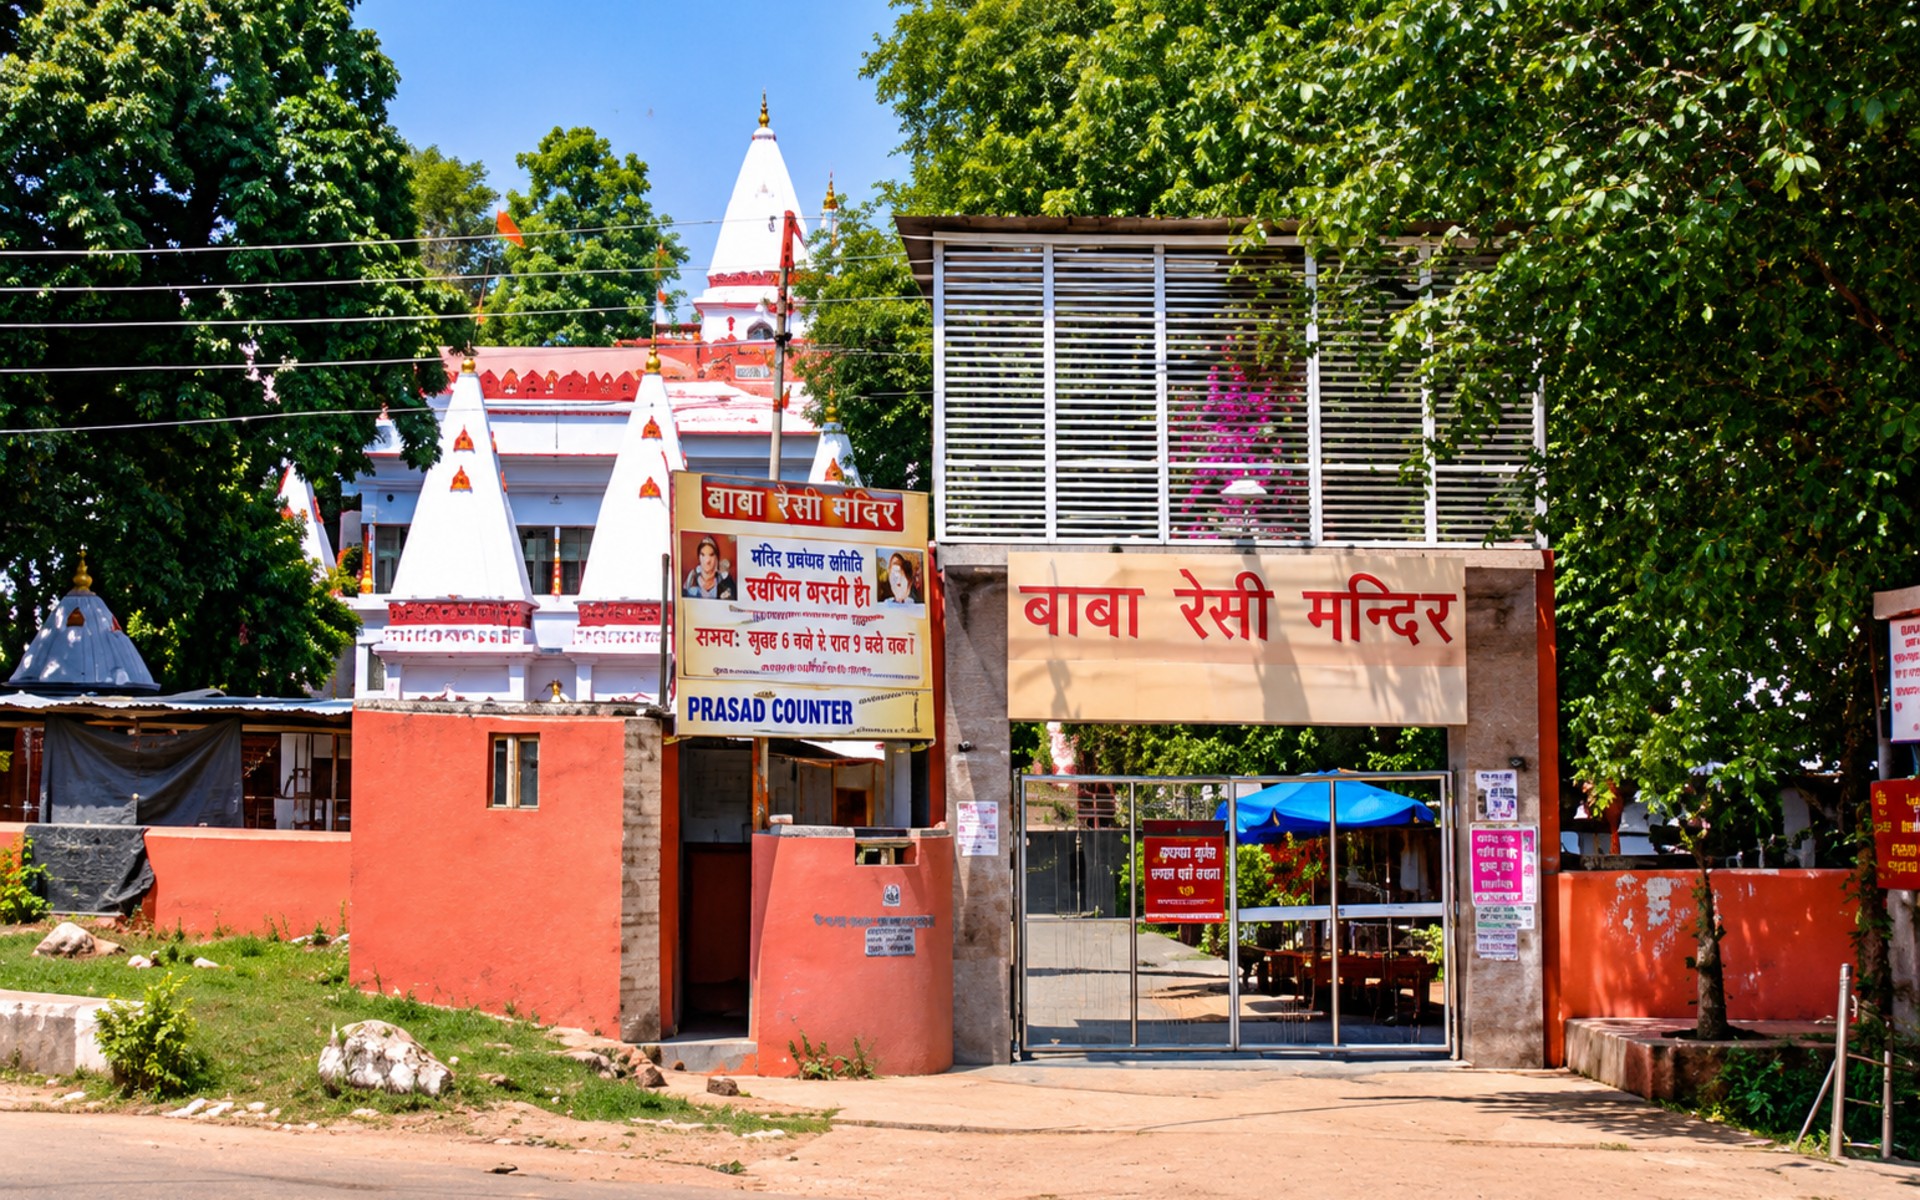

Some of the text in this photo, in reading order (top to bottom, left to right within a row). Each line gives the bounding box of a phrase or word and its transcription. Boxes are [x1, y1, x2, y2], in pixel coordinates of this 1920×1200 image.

[706, 486, 765, 517] बाबा
[832, 489, 897, 527] मंदिर
[1019, 568, 1457, 646] बाबा रेसी मन्दिर
[781, 632, 789, 649] 6
[853, 634, 860, 653] 9
[687, 696, 853, 725] PRASAD COUNTER
